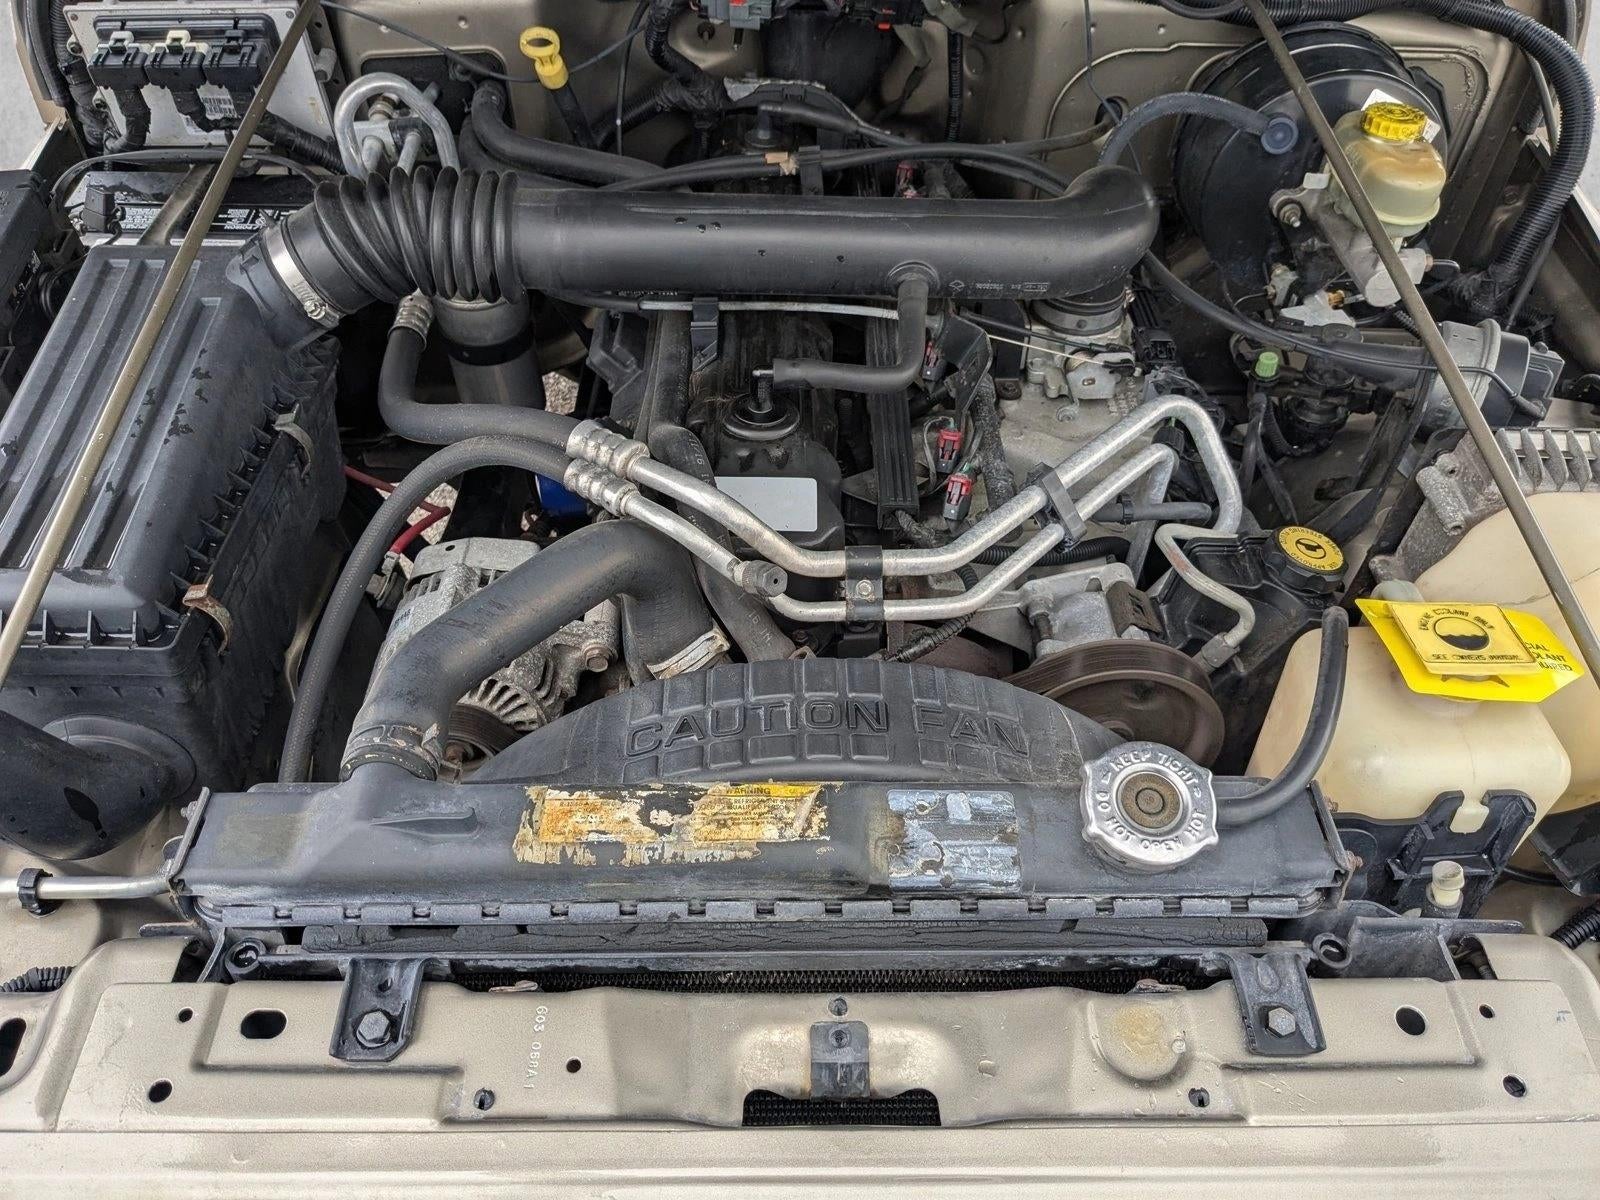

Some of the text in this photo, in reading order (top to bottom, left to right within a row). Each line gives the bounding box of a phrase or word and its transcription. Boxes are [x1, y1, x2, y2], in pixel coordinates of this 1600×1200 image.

[1525, 641, 1551, 652] CIAL
[1432, 653, 1449, 661] SEE
[1532, 651, 1567, 663] OLANT
[1538, 661, 1573, 671] UIRED
[625, 699, 1031, 759] CAUTION FAN
[1109, 750, 1199, 785] KEEP TIGHT
[1096, 790, 1111, 812] DO
[1105, 816, 1137, 841] NOT
[1183, 808, 1207, 839] HOT
